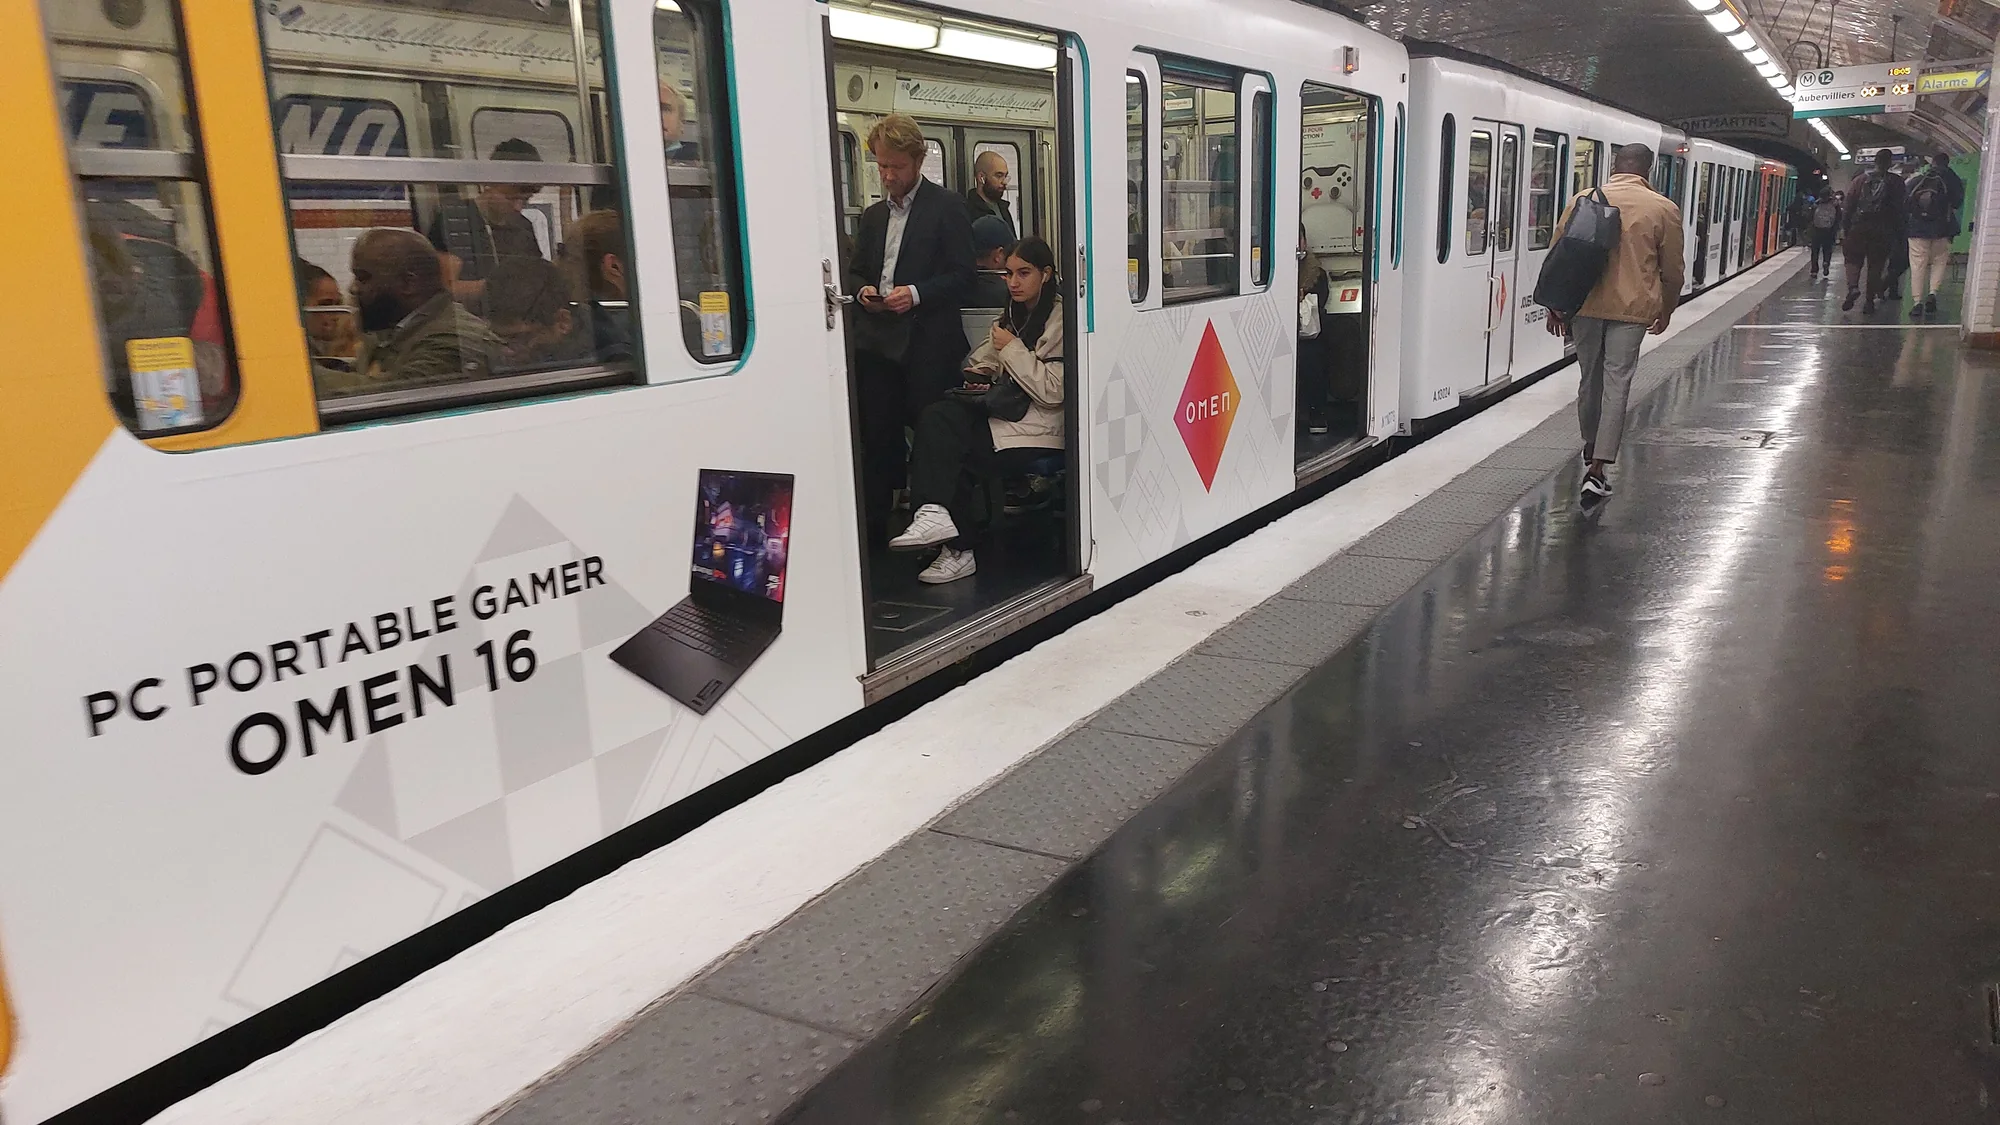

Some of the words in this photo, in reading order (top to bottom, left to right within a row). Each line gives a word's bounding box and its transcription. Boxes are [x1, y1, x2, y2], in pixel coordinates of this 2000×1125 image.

[1819, 73, 1833, 84] 12
[1922, 77, 1968, 90] Alarme
[1798, 90, 1856, 102] Aubervilliers
[1860, 86, 1878, 98] 00
[1891, 83, 1909, 95] 03
[1680, 117, 1767, 131] ONTMARTRE
[82, 678, 172, 738] PC
[184, 594, 460, 707] PORTABLE
[471, 555, 607, 621] GAMER
[226, 653, 457, 776] OMEN
[473, 629, 537, 692] 16
